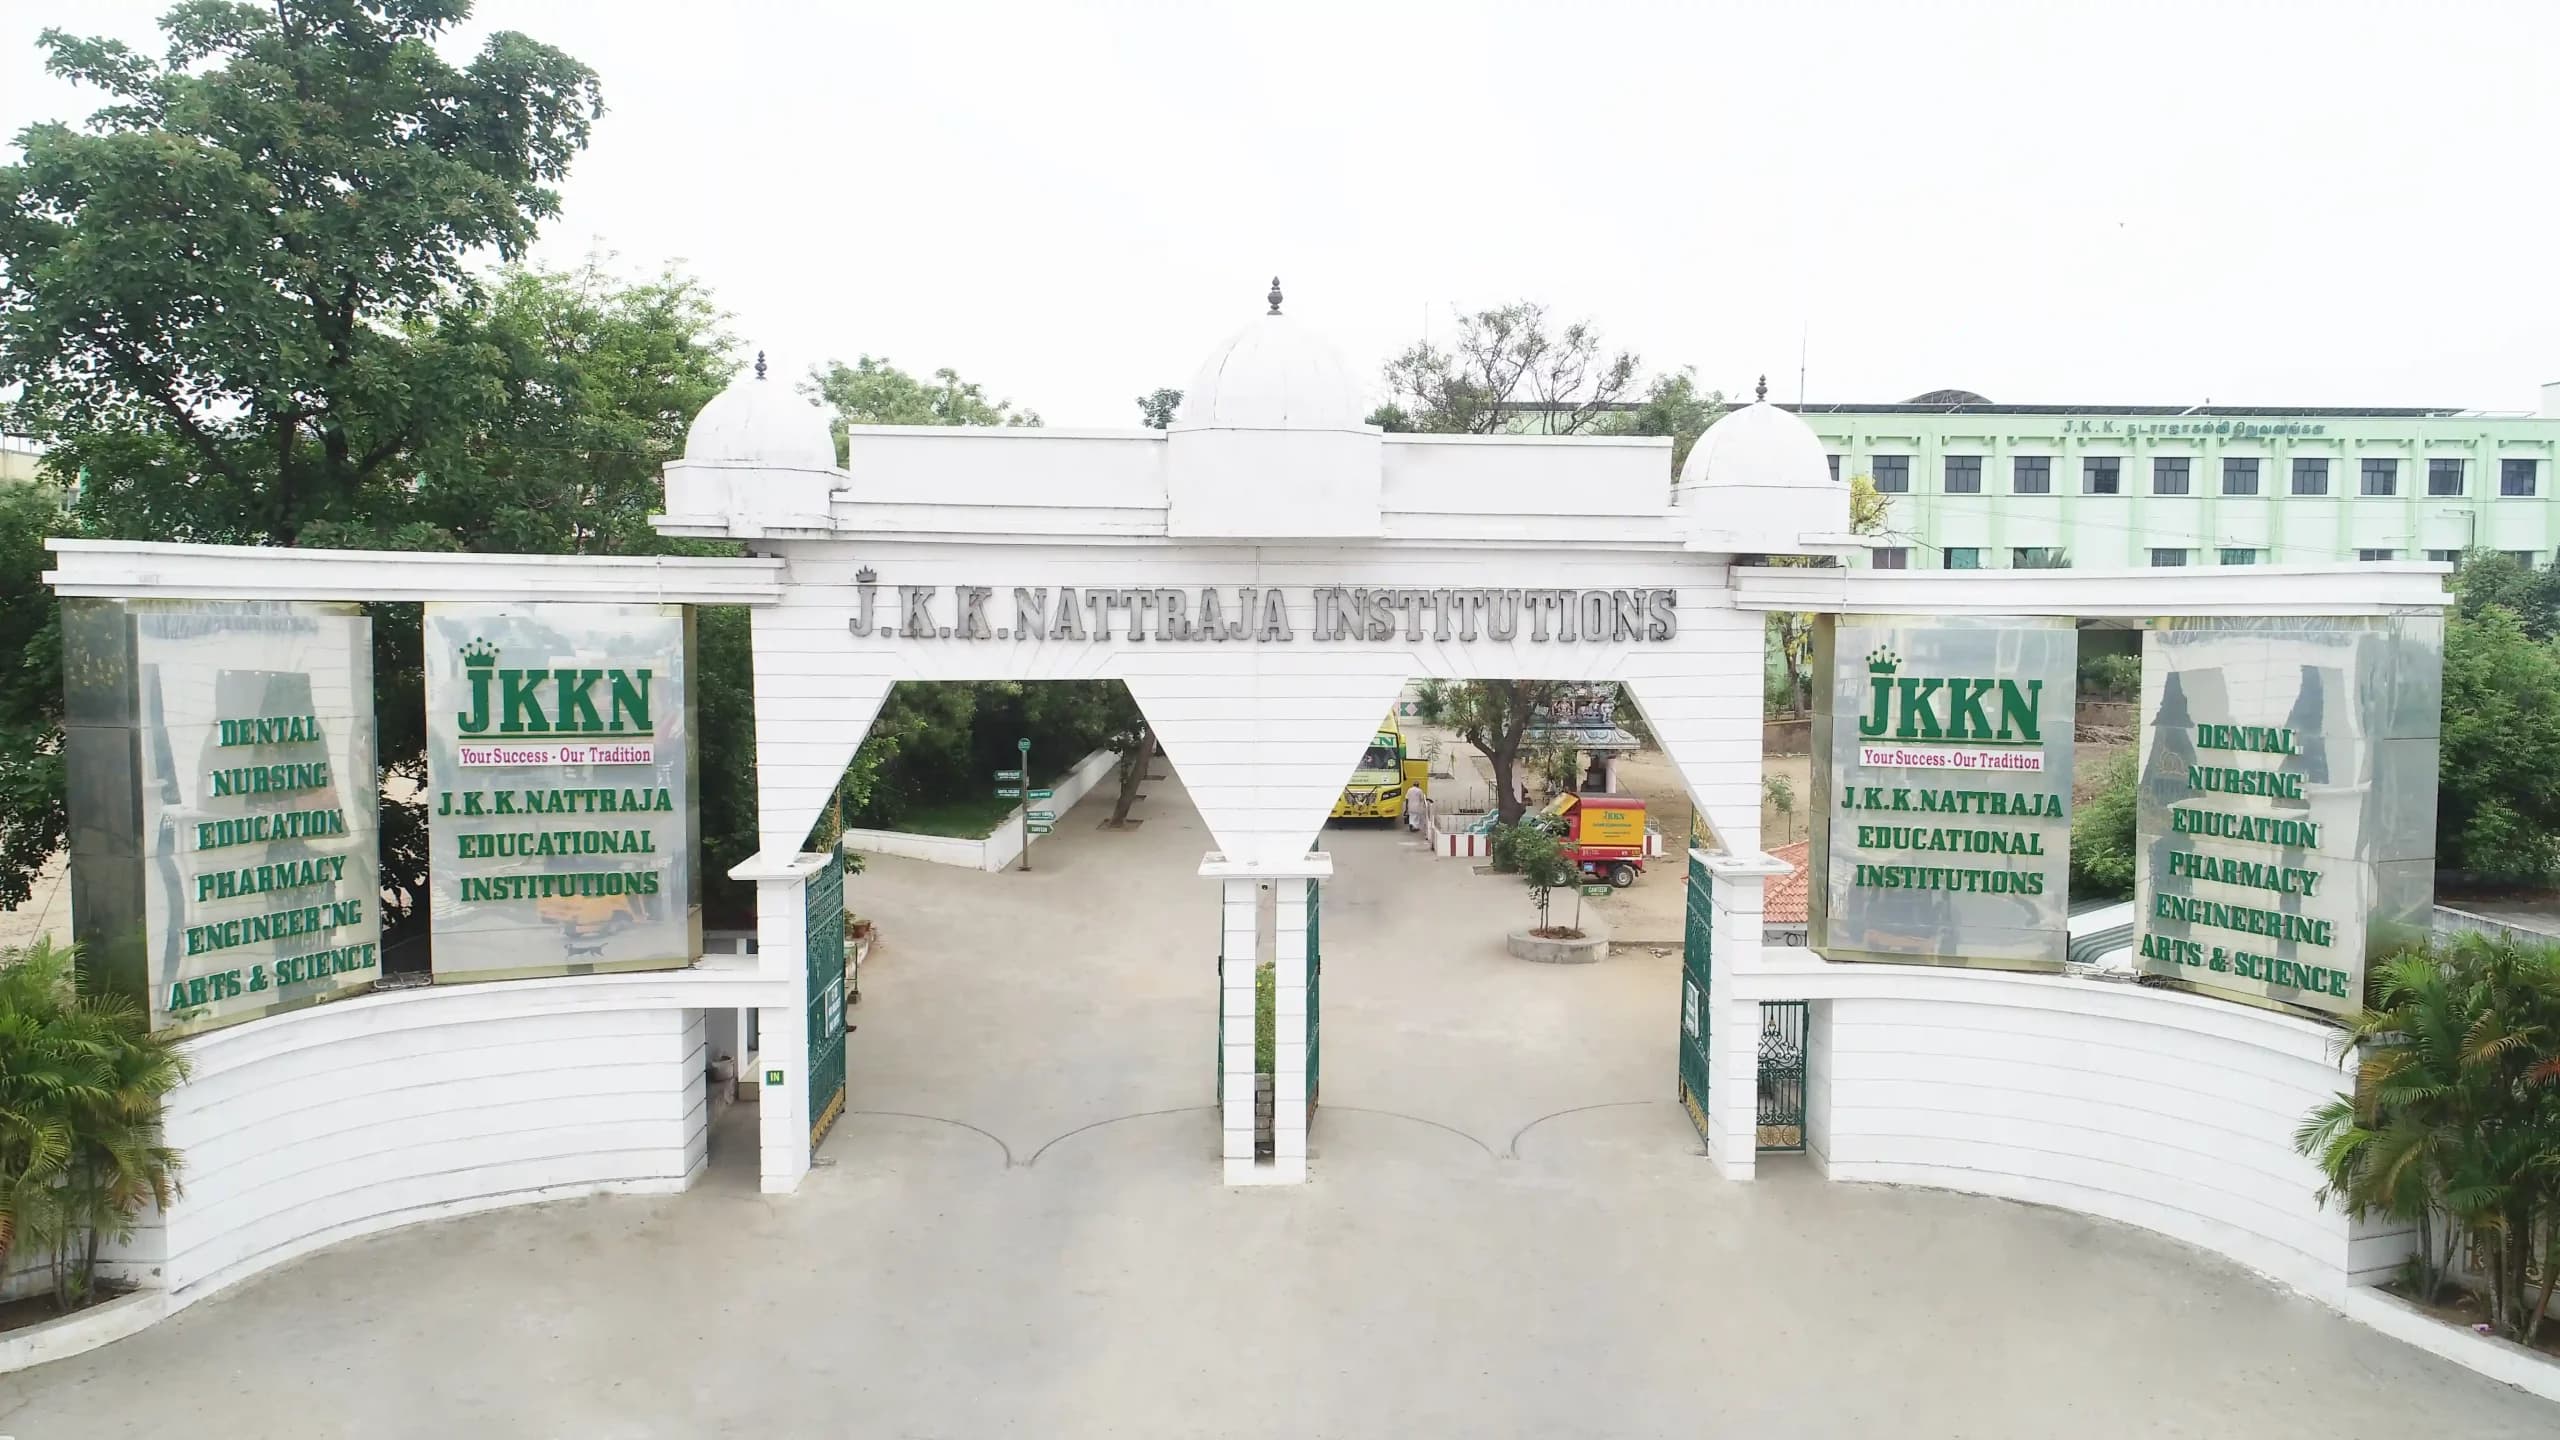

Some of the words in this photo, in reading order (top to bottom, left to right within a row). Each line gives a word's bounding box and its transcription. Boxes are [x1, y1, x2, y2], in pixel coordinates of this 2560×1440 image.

[849, 586, 1294, 642] J.K.K.NATTRAJA
[1313, 587, 1678, 642] INSTITUTIONS
[458, 669, 653, 733] JKKN
[1859, 676, 2043, 740] JKKN
[220, 715, 319, 748] DENTAL
[2197, 723, 2298, 755] DENTAL
[461, 748, 491, 763] Your
[494, 748, 548, 763] Success
[560, 747, 585, 762] Our
[589, 746, 651, 762] Tradition
[1865, 749, 1894, 765] Your
[1896, 750, 1945, 766] Success
[1953, 752, 1977, 767] Our
[1980, 753, 2040, 770] Tradition
[213, 763, 327, 797] NURSING
[2188, 766, 2303, 800] NURSING
[439, 788, 673, 817] J.K.K.NATTRAJA
[1842, 786, 2064, 818] J.K.K.NATTRAJA
[198, 810, 343, 851] EDUCATION
[458, 830, 655, 859] EDUCATIONAL
[1858, 826, 2044, 856] EDUCATIONAL
[2173, 807, 2318, 849] EDUCATION
[197, 855, 346, 903] PHARMACY
[460, 872, 659, 902] INSTITUTIONS
[1856, 864, 2044, 896] INSTITUTIONS
[2168, 852, 2319, 898] PHARMACY
[2156, 893, 2331, 948] ENGINEERING
[169, 970, 241, 1012] ARTS
[249, 966, 268, 992] &
[274, 944, 376, 984] SCIENCE
[2141, 934, 2202, 966] ARTS
[2209, 947, 2228, 972] &
[2234, 952, 2350, 998] SCIENCE
[770, 1072, 780, 1082] IN
